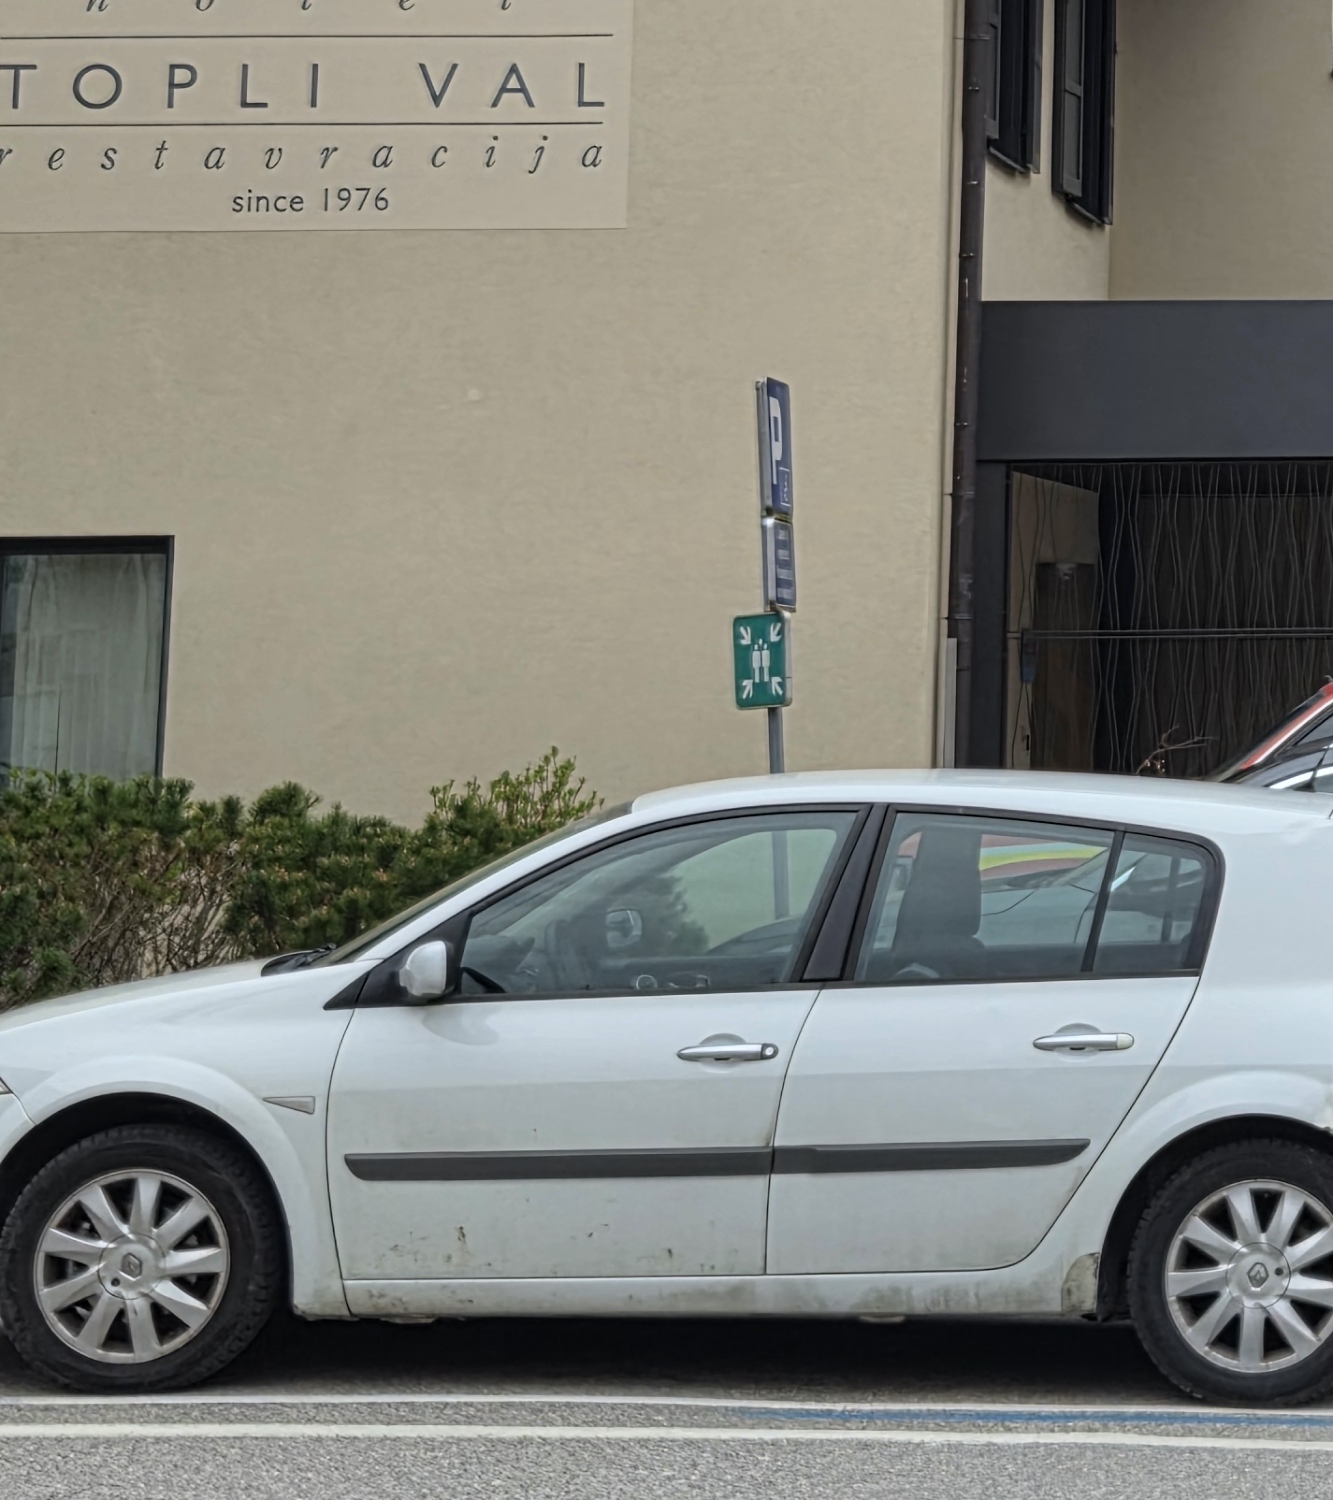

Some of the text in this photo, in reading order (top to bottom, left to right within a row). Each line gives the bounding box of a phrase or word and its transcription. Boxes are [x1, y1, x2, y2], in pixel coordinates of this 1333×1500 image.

[0, 62, 605, 109] TOPLI VAL
[0, 135, 603, 175] restavracija
[232, 187, 389, 213] since 1976
